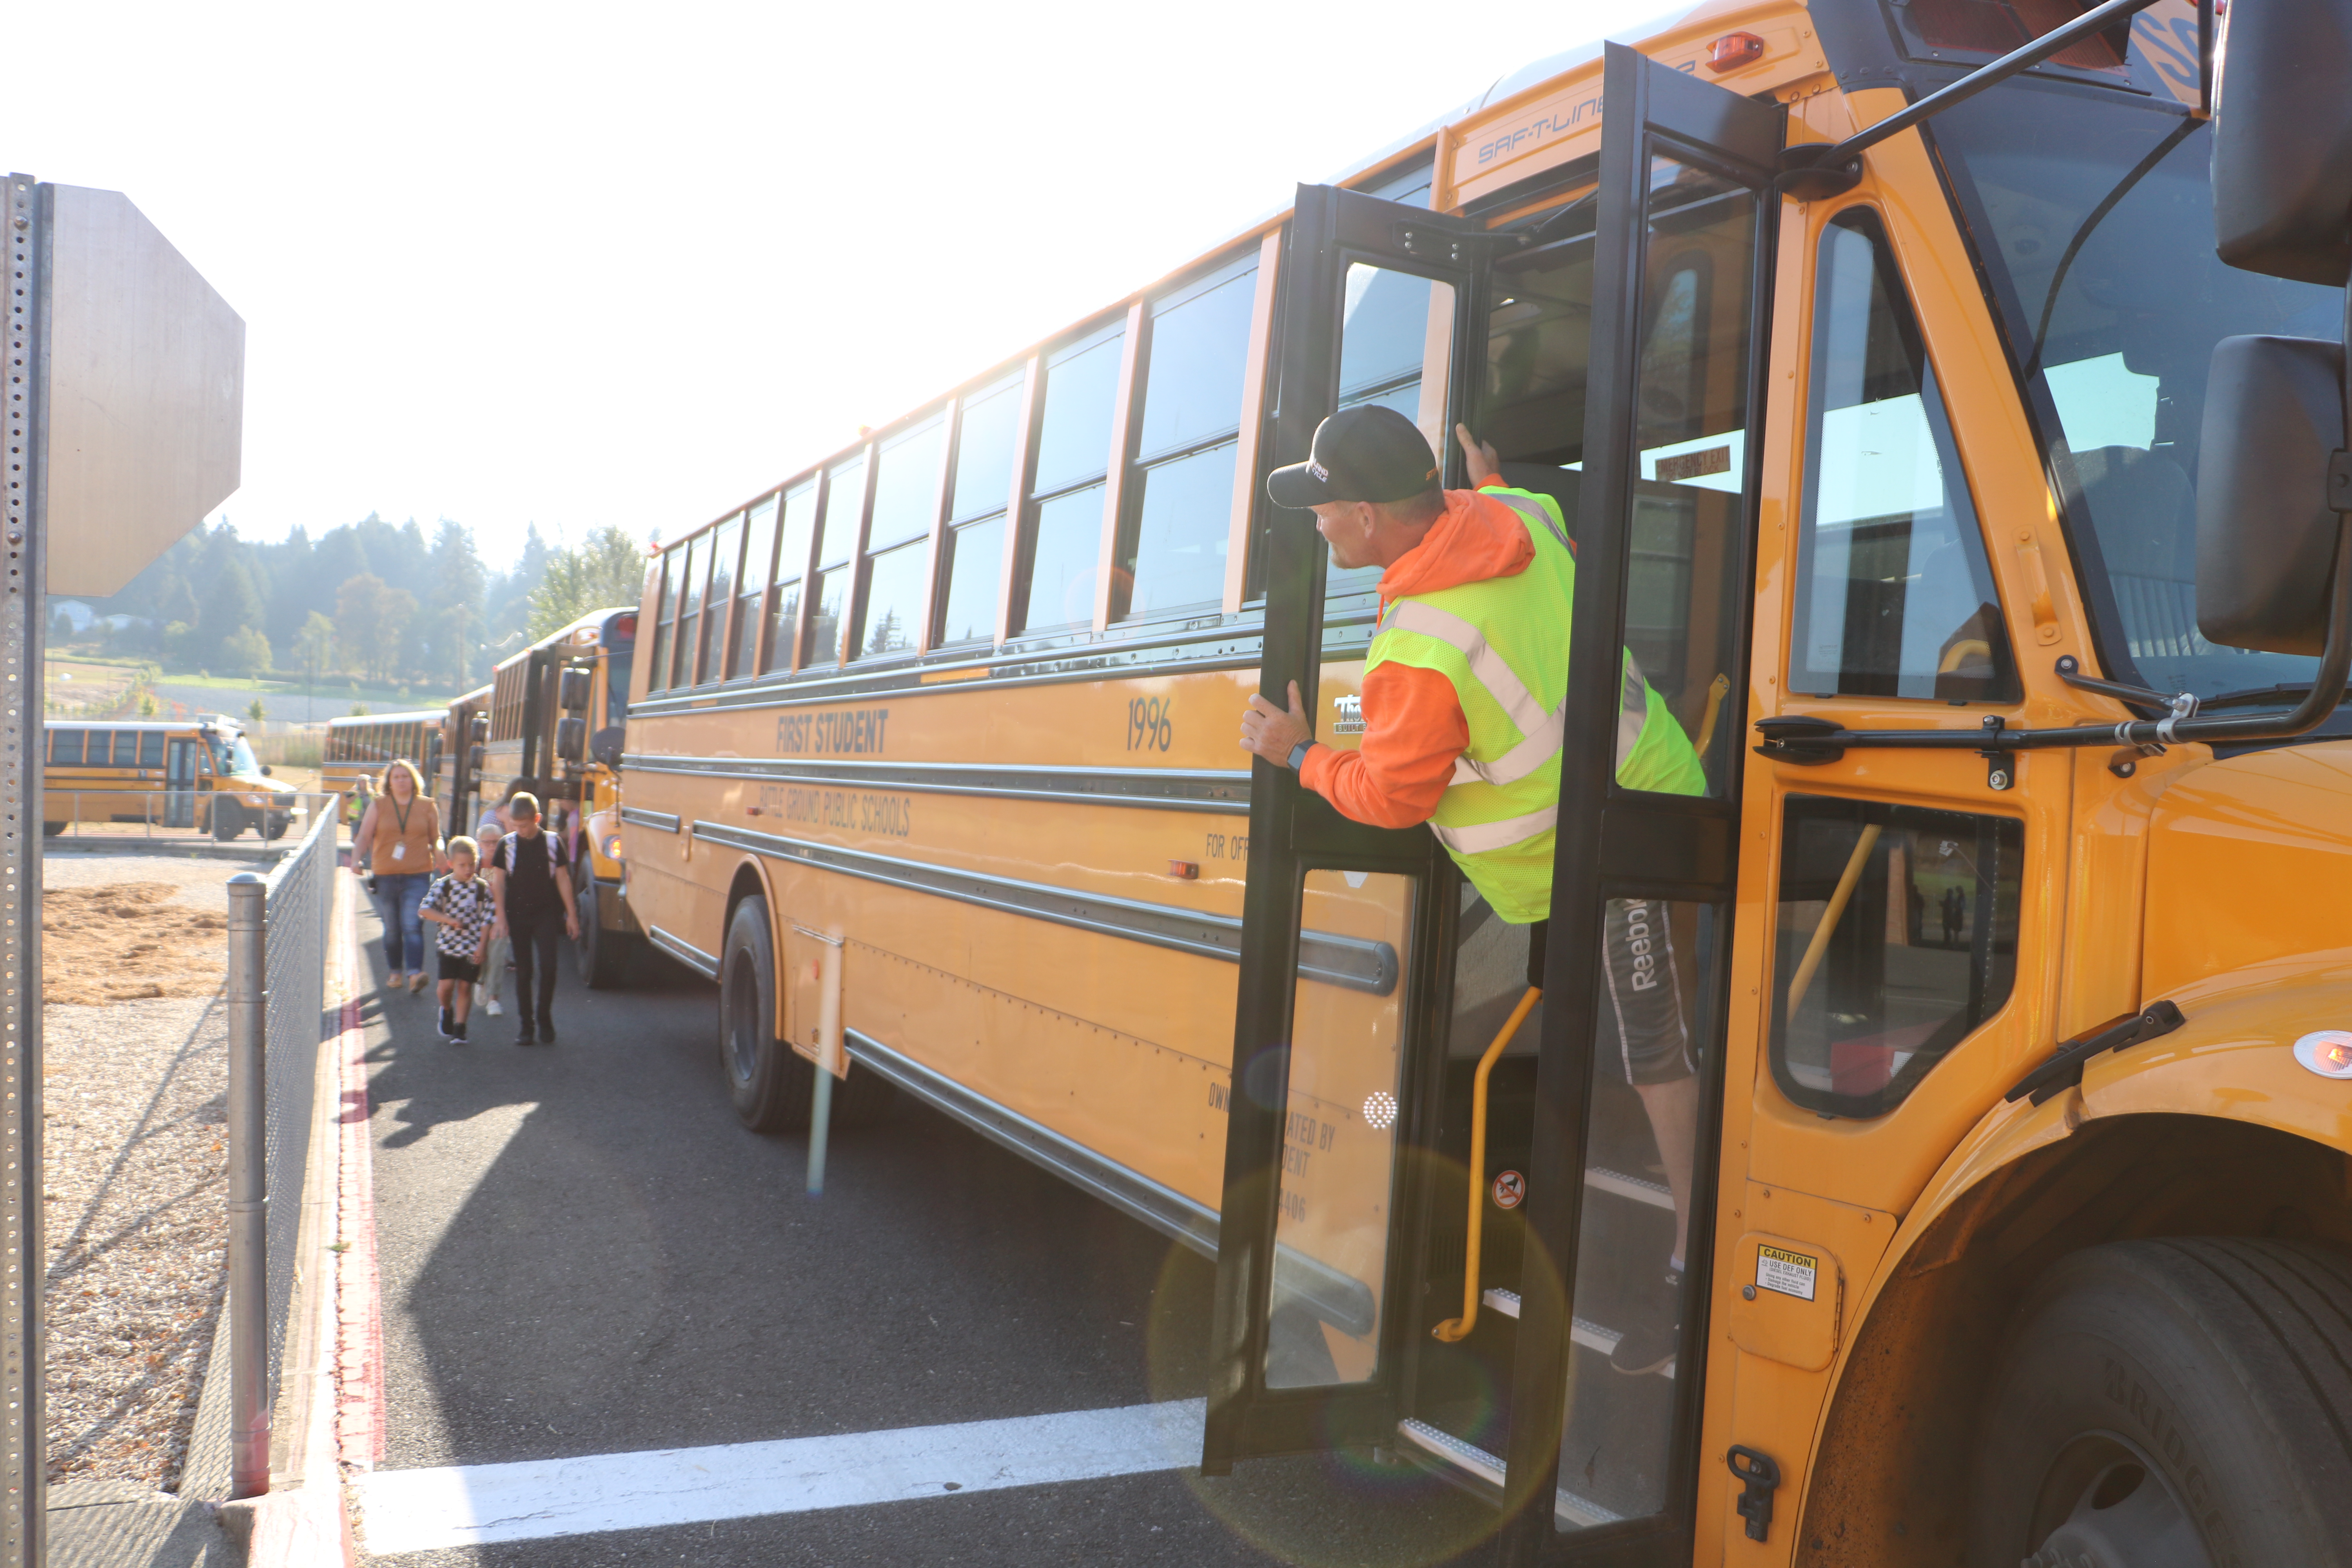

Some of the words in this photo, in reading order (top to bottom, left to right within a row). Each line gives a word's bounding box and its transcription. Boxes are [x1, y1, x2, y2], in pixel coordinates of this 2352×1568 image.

[1314, 458, 1328, 477] LAND
[1711, 446, 1729, 465] EXIT
[1334, 694, 1361, 722] Tho
[776, 714, 813, 753] FIRST
[815, 709, 889, 753] STUDENT
[1127, 696, 1172, 752] 1996
[787, 788, 820, 823] GROUND
[824, 791, 857, 829] PUBLIC
[861, 794, 910, 837] SCHOOLS
[1206, 833, 1225, 858] FOR
[1286, 1111, 1316, 1145] ATED
[1319, 1123, 1336, 1153] BY
[1764, 1248, 1811, 1267] CAUTION
[1769, 1260, 1781, 1269] USE
[1783, 1263, 1795, 1272] DEF
[1796, 1267, 1812, 1276] ONLY
[2103, 1356, 2242, 1568] BRIDGE
